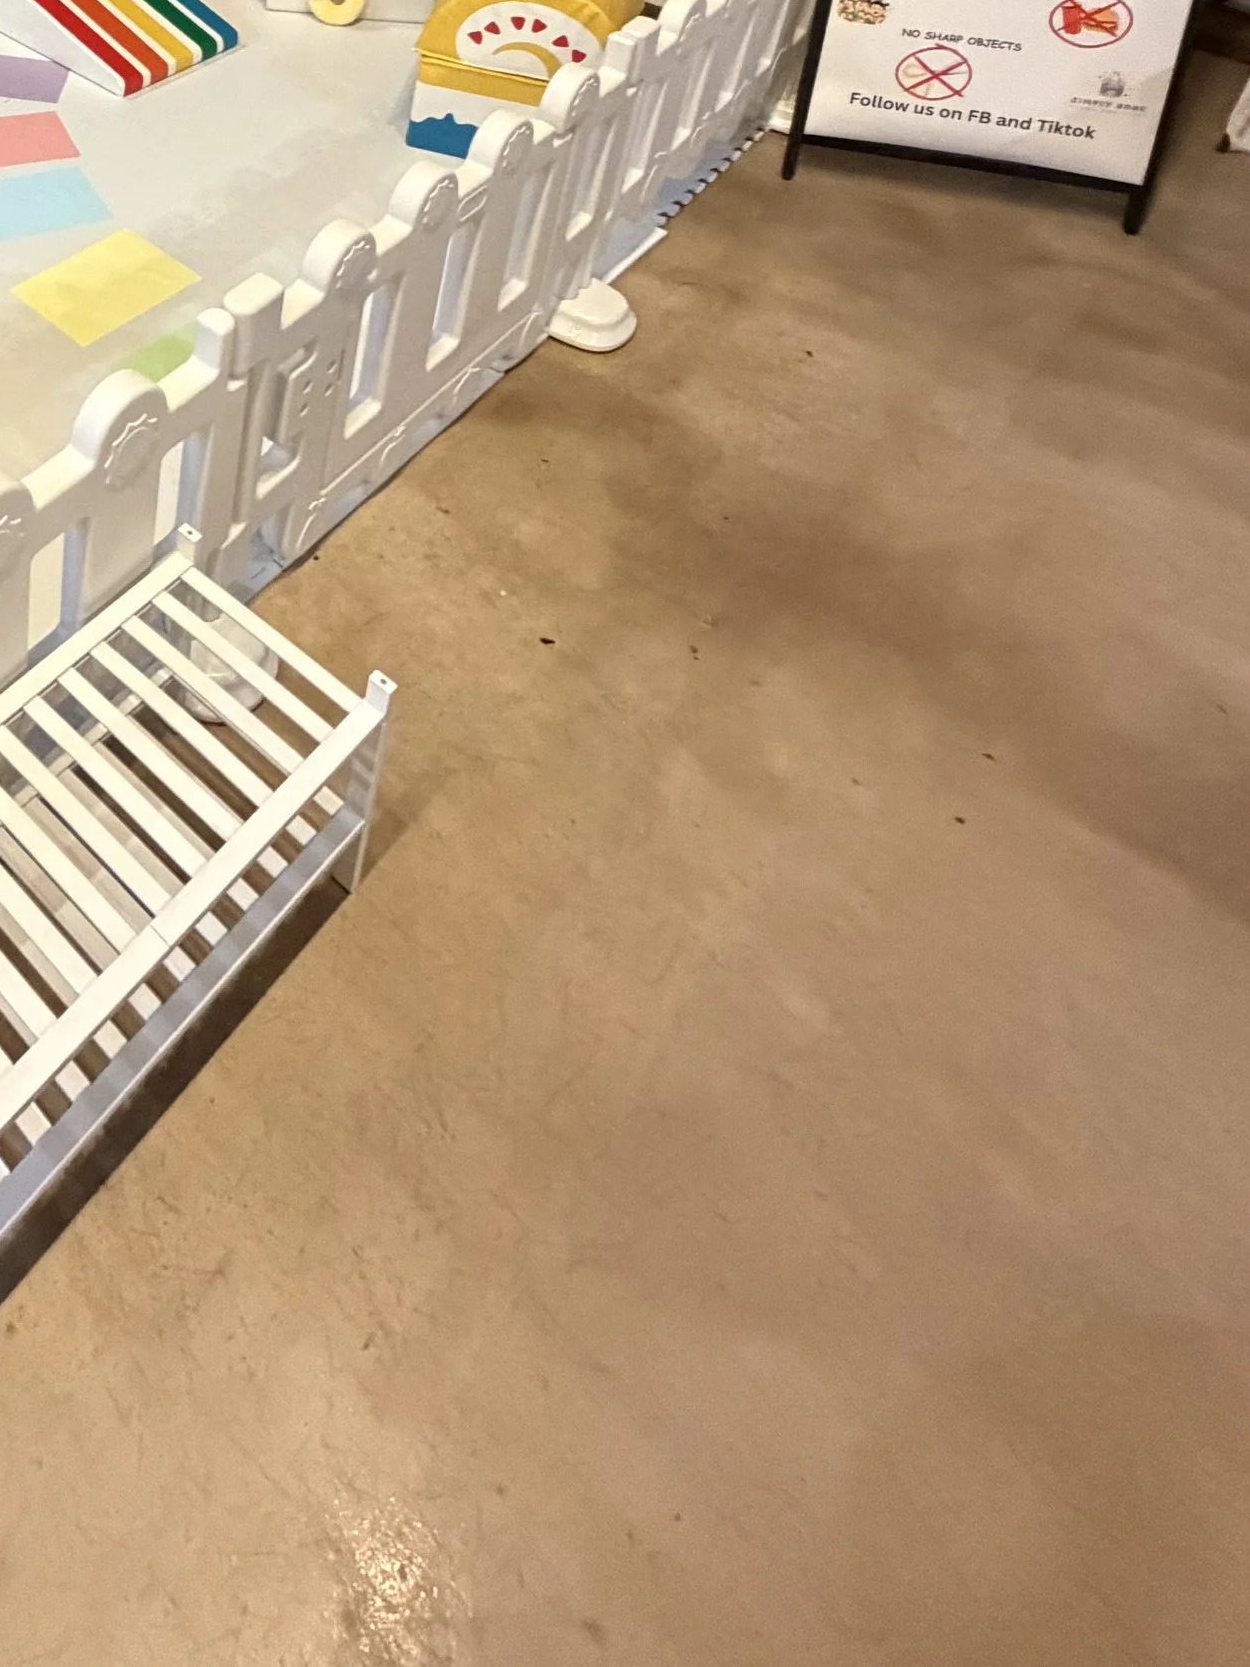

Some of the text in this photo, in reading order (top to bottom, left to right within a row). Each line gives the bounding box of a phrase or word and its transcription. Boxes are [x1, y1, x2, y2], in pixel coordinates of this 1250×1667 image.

[901, 28, 1022, 52] NO SHARP OBJECTS
[850, 92, 1096, 140] Follow us on FB and Tiktok
